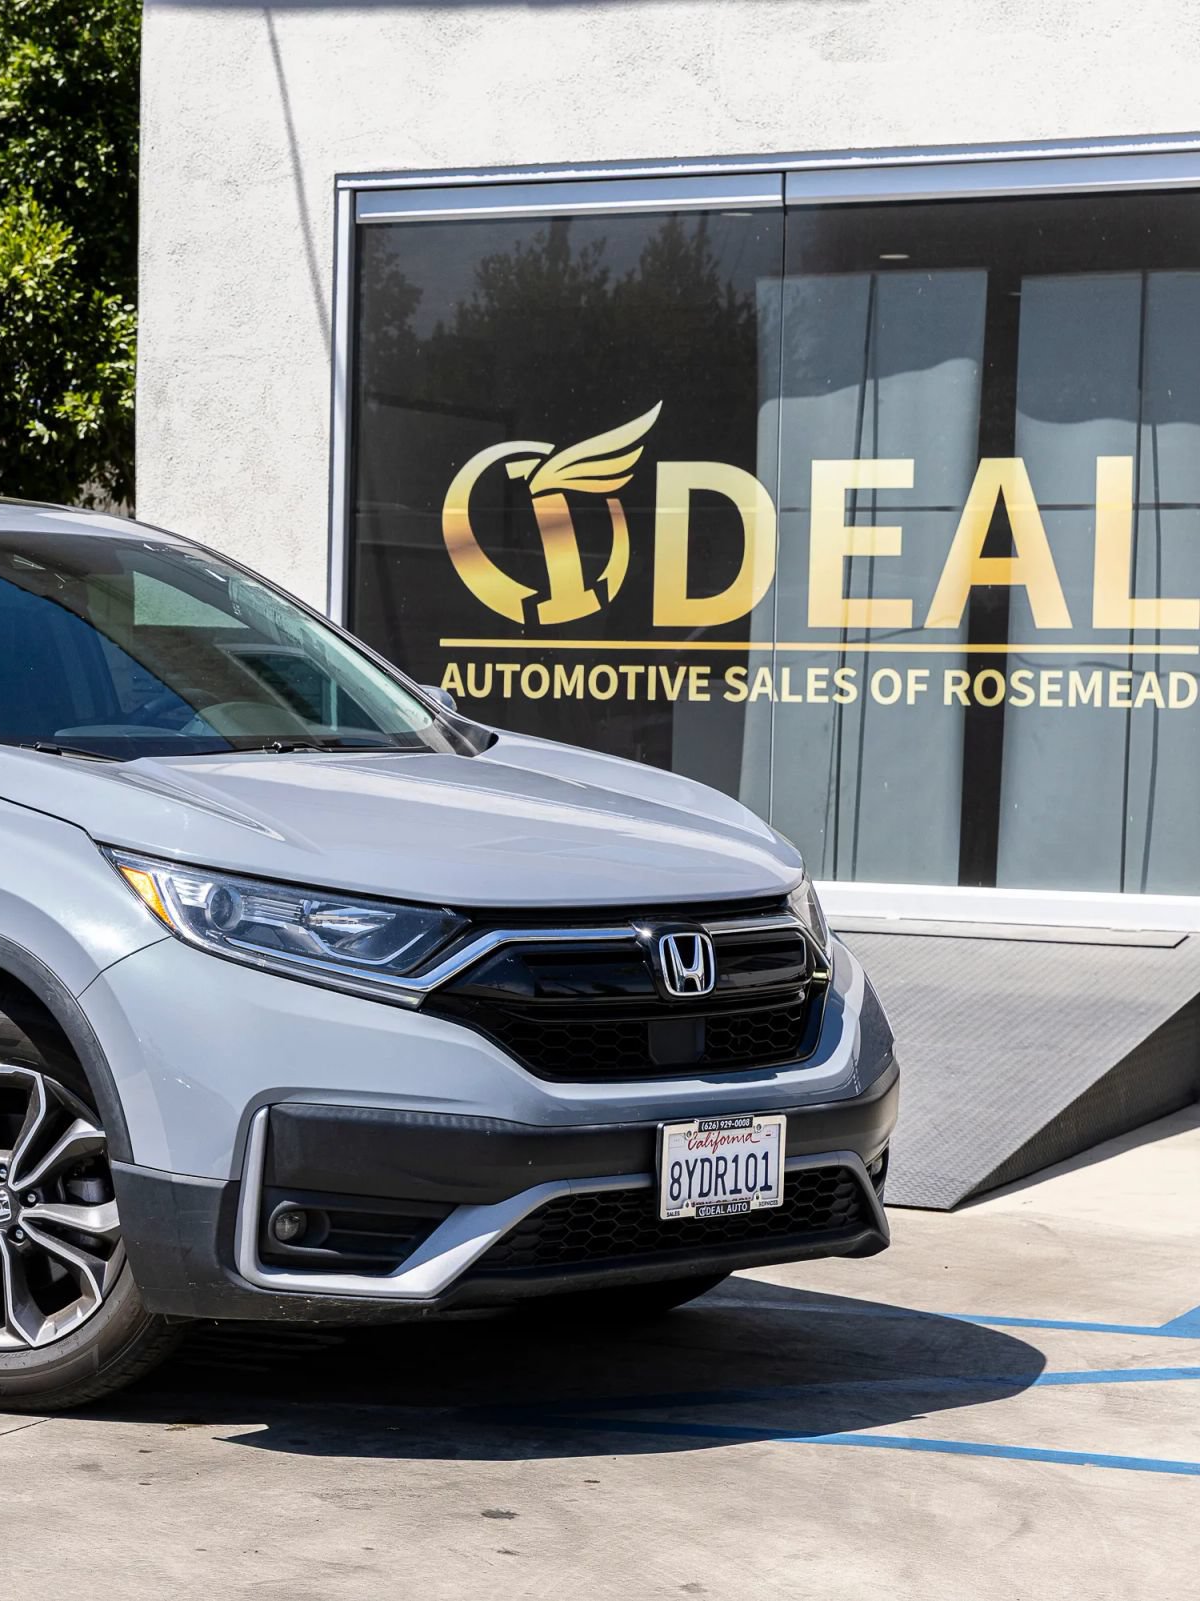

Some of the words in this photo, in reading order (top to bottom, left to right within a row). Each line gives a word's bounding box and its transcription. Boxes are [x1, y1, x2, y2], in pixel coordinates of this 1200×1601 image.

[439, 662, 711, 701] AUTOMOTIVE
[723, 665, 858, 704] SALES
[870, 668, 930, 705] OF
[943, 669, 1199, 709] ROSEMEAD
[701, 1120, 719, 1131] (626)
[688, 1130, 760, 1154] California
[669, 1151, 773, 1201] 8YDR101
[726, 1202, 748, 1214] AUTO
